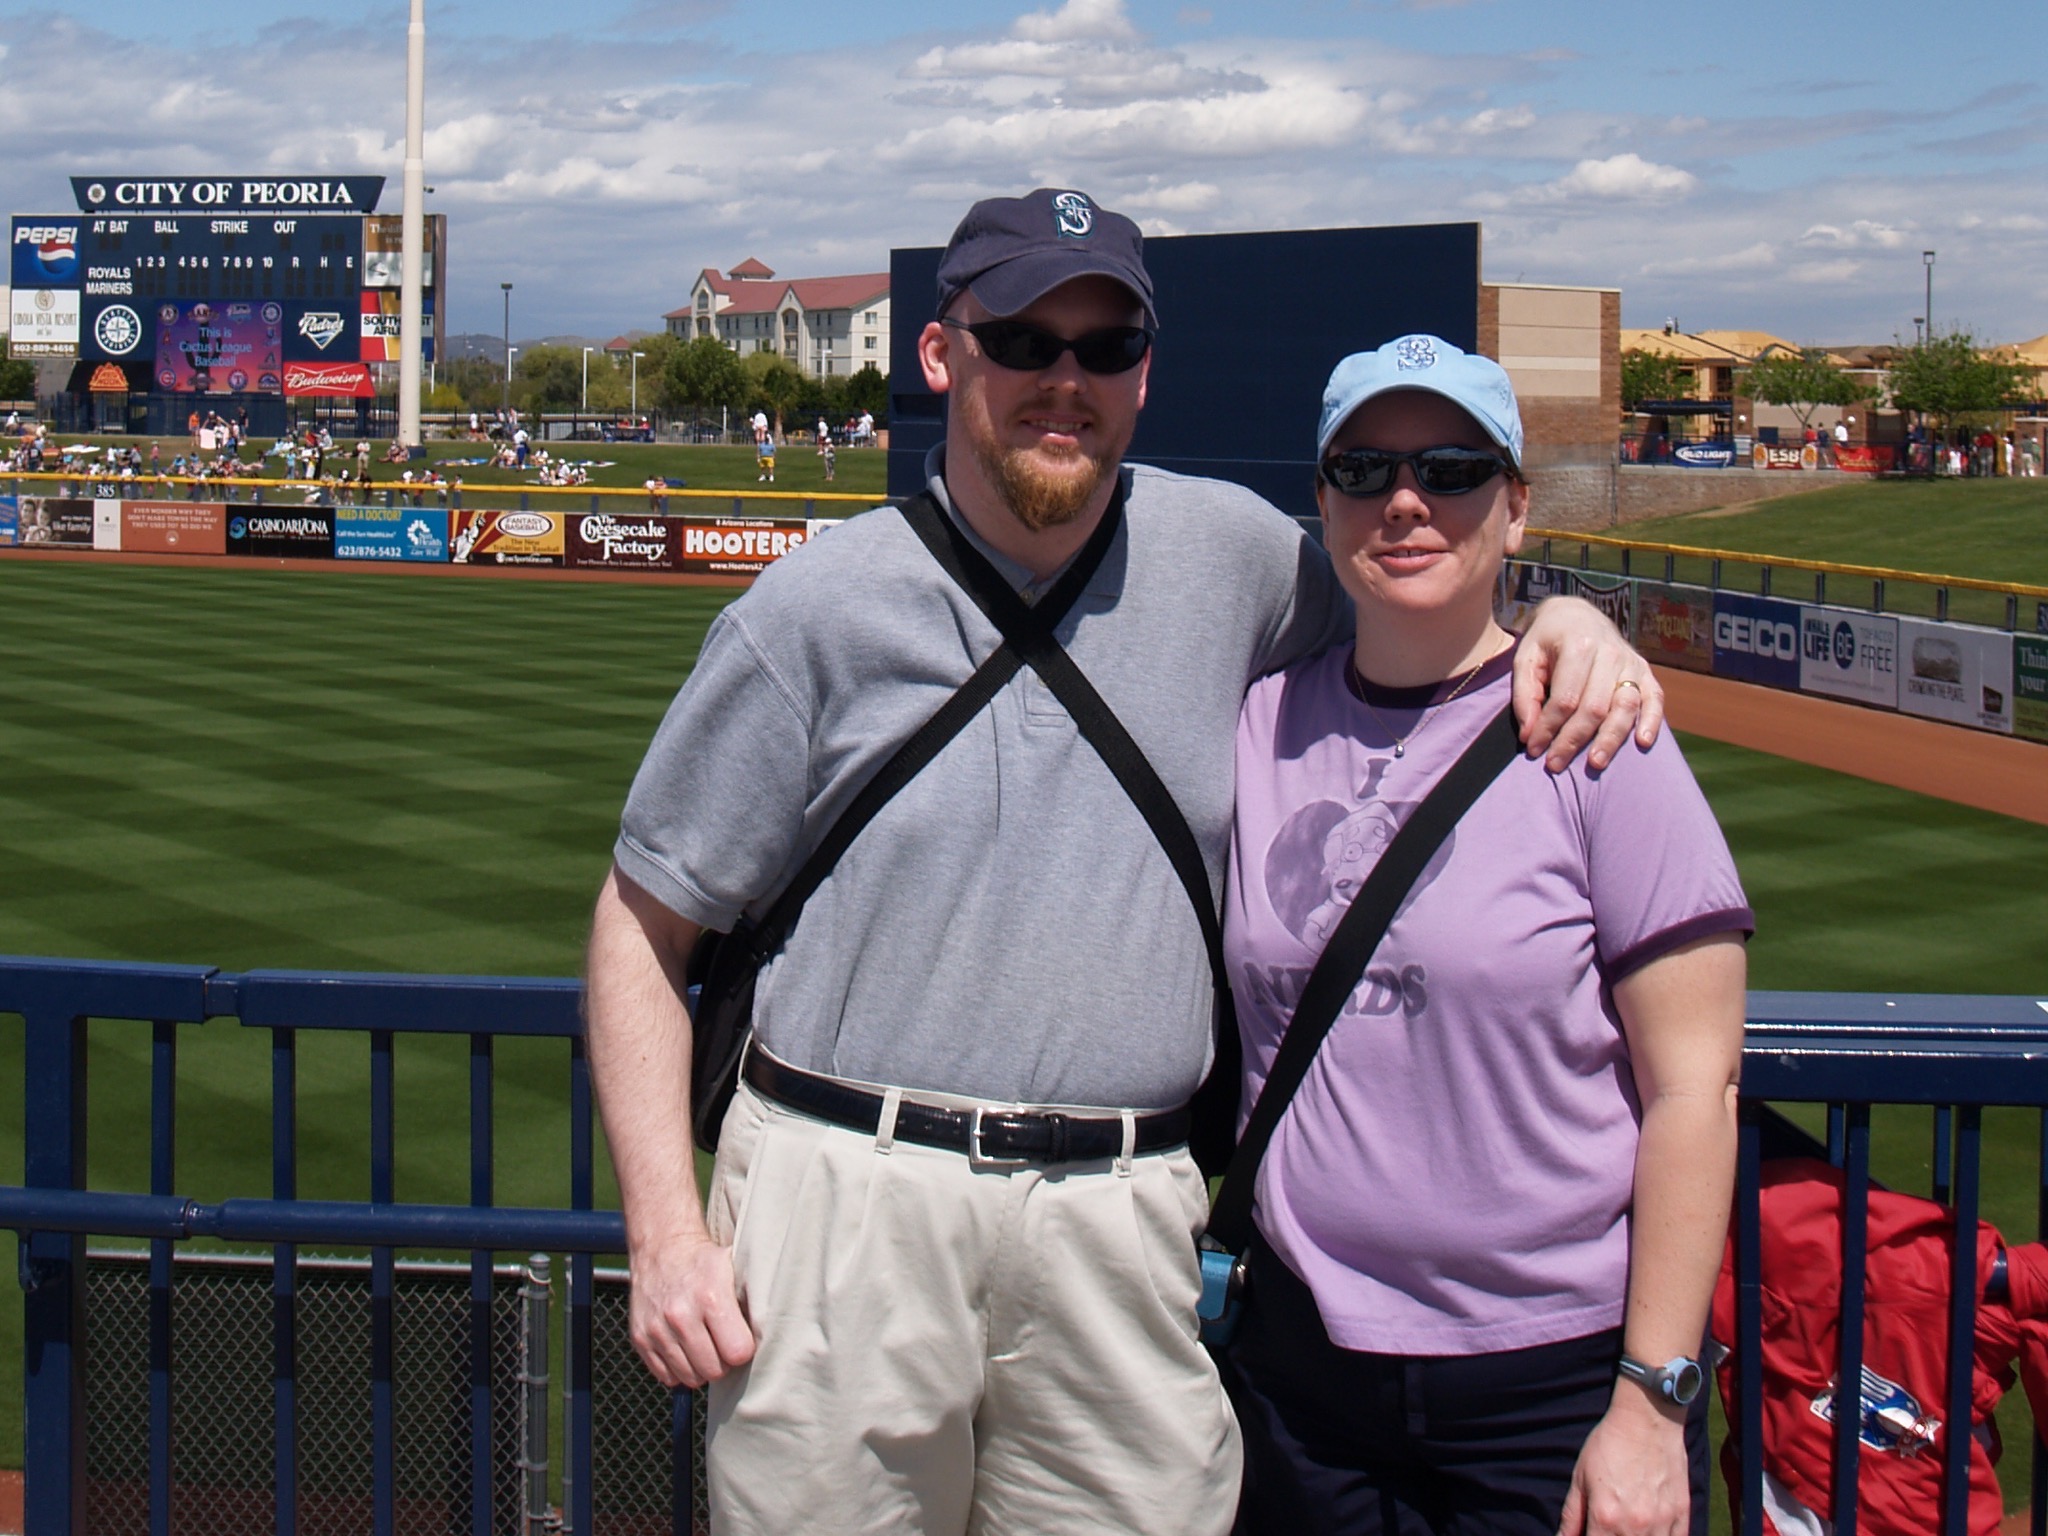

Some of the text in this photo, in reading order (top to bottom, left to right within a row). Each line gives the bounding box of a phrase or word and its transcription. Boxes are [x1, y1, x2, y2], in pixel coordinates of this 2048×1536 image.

[115, 182, 354, 204] CITY OF PEORIA
[93, 220, 129, 233] AT BAT
[154, 220, 180, 233] BALL
[210, 220, 249, 234] STRIKE
[273, 220, 297, 233] OUT
[14, 226, 78, 244] PEPSI
[136, 256, 353, 268] 1 2 3 4 5 6 7 8 9 10 R H E
[88, 267, 131, 279] ROYALS
[86, 282, 133, 296] MARINERS
[36, 313, 52, 326] VISTA
[55, 313, 77, 326] RESORT
[299, 316, 345, 336] Padres
[363, 316, 431, 326] SOUTHST
[199, 328, 232, 338] This is
[179, 341, 253, 355] Cactus League
[195, 356, 236, 367] Baseball
[284, 371, 365, 389] Budweiser
[1682, 449, 1733, 461] BUD LIGHT
[1769, 448, 1800, 463] ESB
[96, 484, 115, 497] 385
[336, 509, 357, 519] NEED
[358, 509, 364, 519] A
[600, 515, 616, 524] The
[52, 521, 66, 531] like
[67, 521, 91, 534] family
[248, 518, 329, 536] CASINO ARIZONA
[580, 516, 667, 543] Cheesecake
[722, 519, 745, 527] Arizona
[746, 520, 774, 528] Locations
[419, 532, 433, 540] Sun
[420, 537, 442, 547] Health
[686, 529, 804, 556] HOOTERS
[338, 545, 402, 557] 623/876-5432
[603, 538, 666, 561] Factory
[1714, 612, 1797, 662] GEICO
[1860, 626, 1893, 643] TOBACCO
[1804, 633, 1830, 662] LIFE
[1836, 632, 1854, 660] BE
[1860, 644, 1893, 673] FREE
[2020, 674, 2046, 695] your
[1357, 758, 1391, 800] I
[1244, 961, 1428, 1018] NDS
